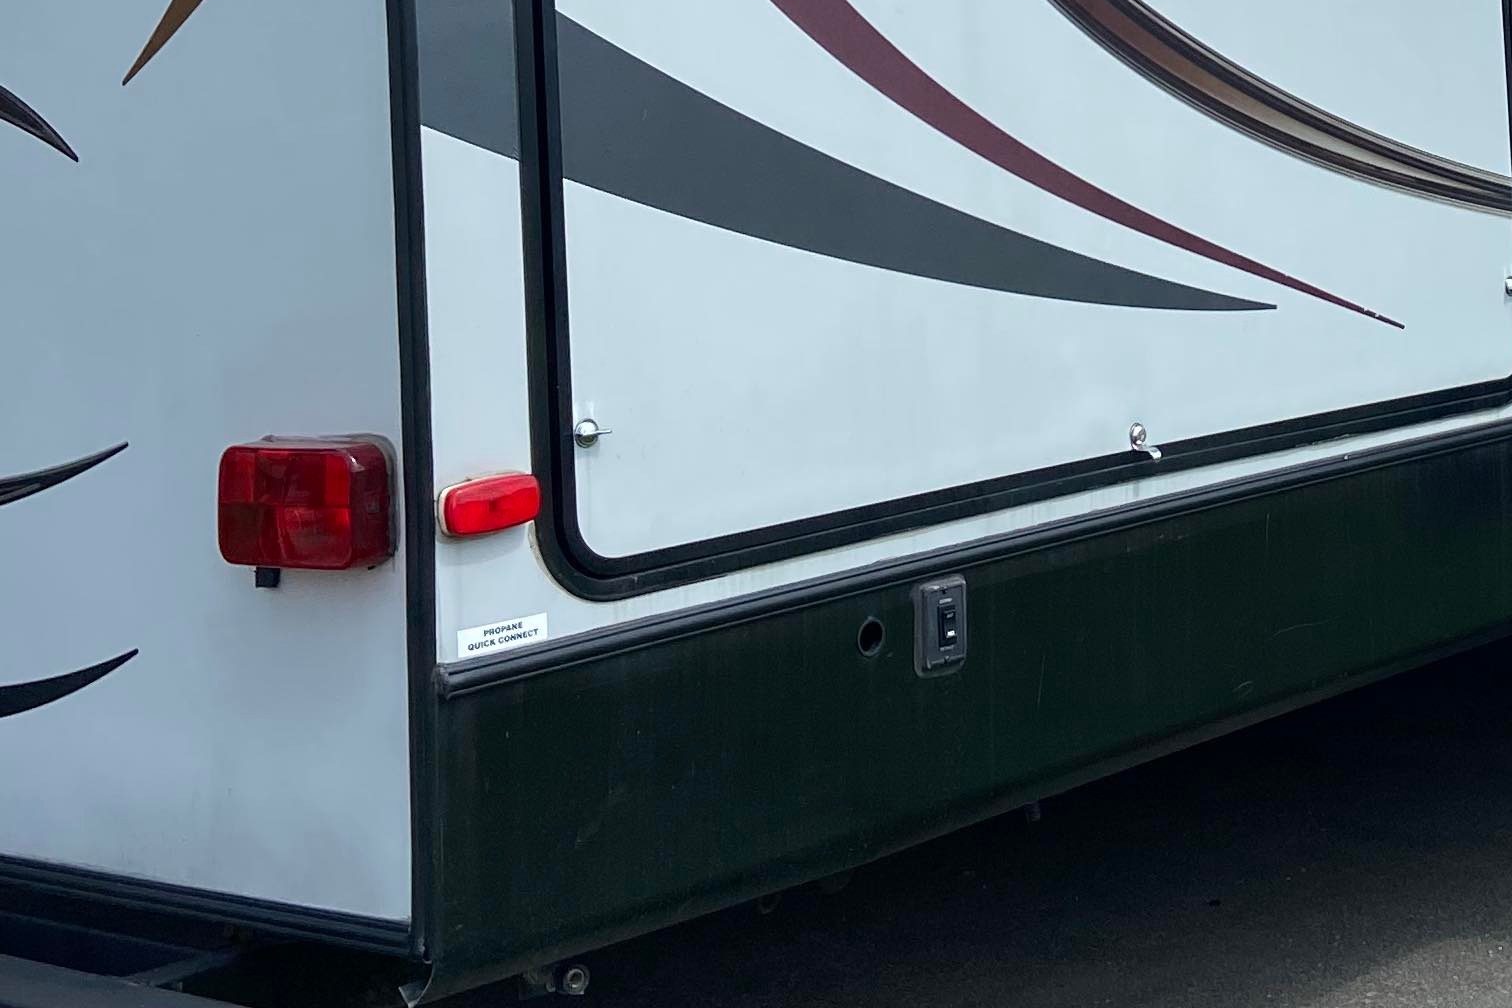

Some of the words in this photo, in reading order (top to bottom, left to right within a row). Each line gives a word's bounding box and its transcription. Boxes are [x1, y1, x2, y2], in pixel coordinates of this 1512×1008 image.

[484, 621, 523, 636] PROPANE
[467, 638, 496, 651] QUICK
[498, 628, 539, 644] CONNECT
